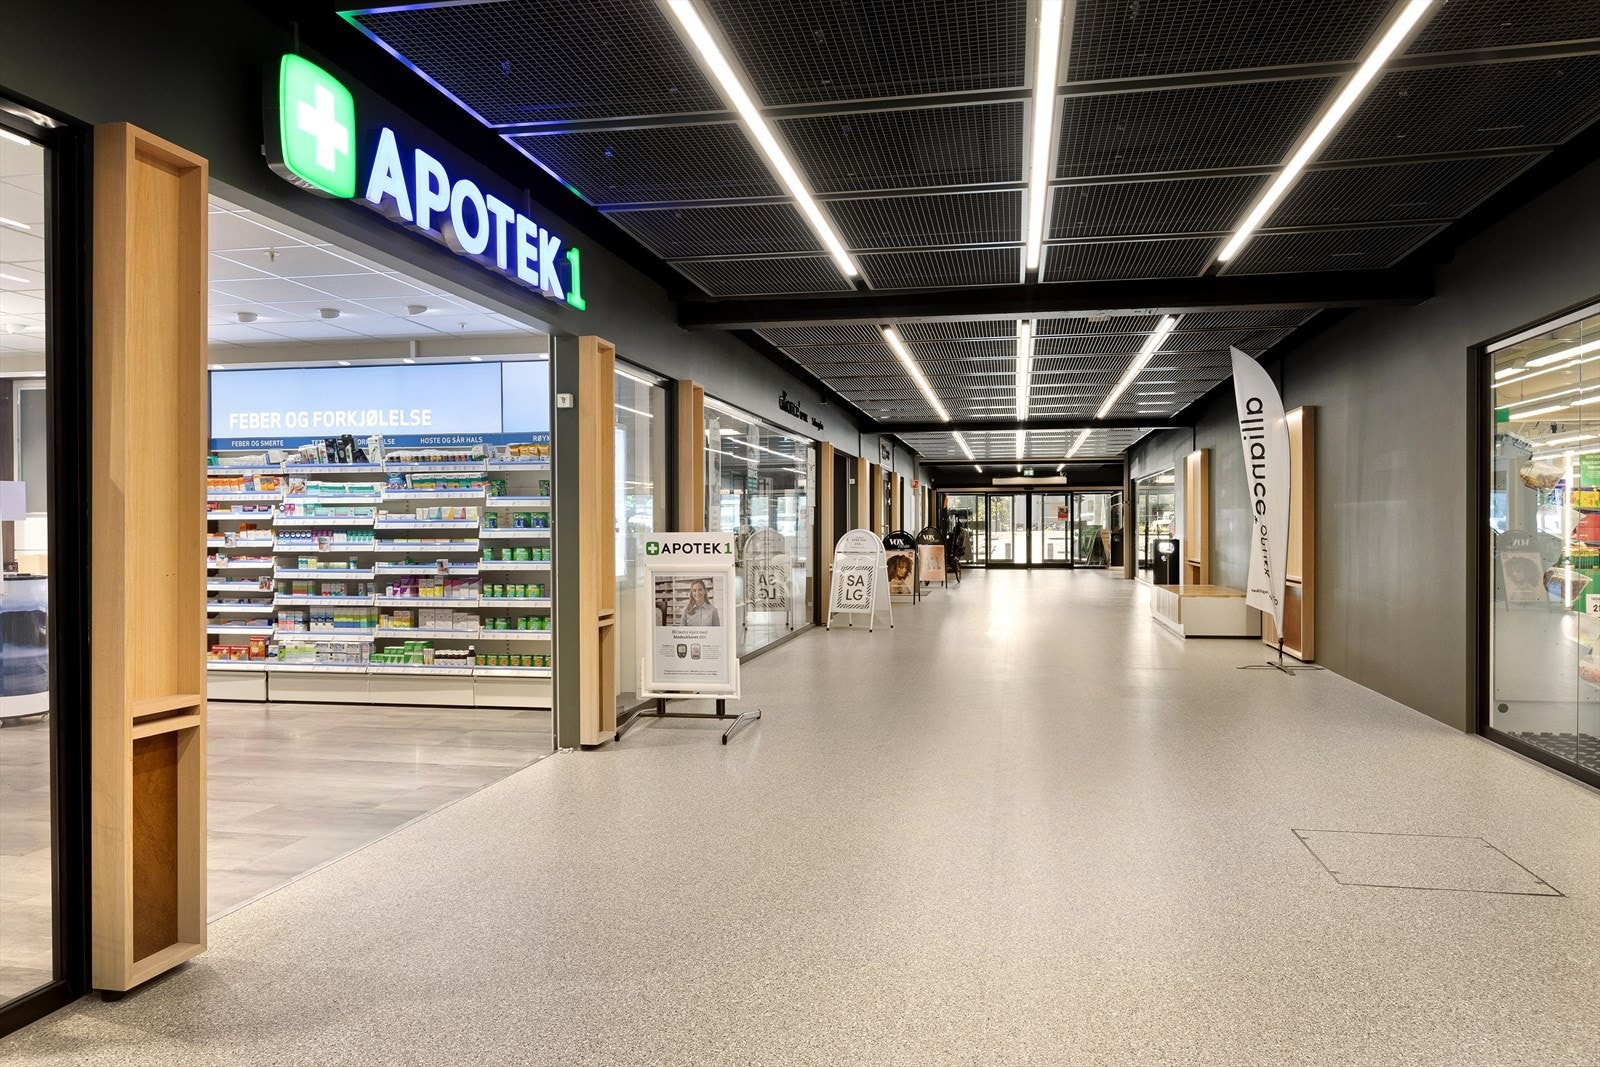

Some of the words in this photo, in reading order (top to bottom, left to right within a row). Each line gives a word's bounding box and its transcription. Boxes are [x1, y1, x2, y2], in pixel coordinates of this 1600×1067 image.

[366, 127, 565, 300] APOTEK
[566, 247, 586, 311] 1
[229, 411, 282, 430] FEBER
[285, 410, 309, 428] OG
[312, 408, 432, 428] FORKJØLELSE
[260, 439, 284, 447] SMERTE
[451, 435, 465, 443] SÅR
[661, 542, 721, 554] APOTEK
[724, 542, 732, 554] 1
[889, 538, 905, 546] VOX
[846, 574, 865, 587] SA
[845, 588, 864, 601] LG
